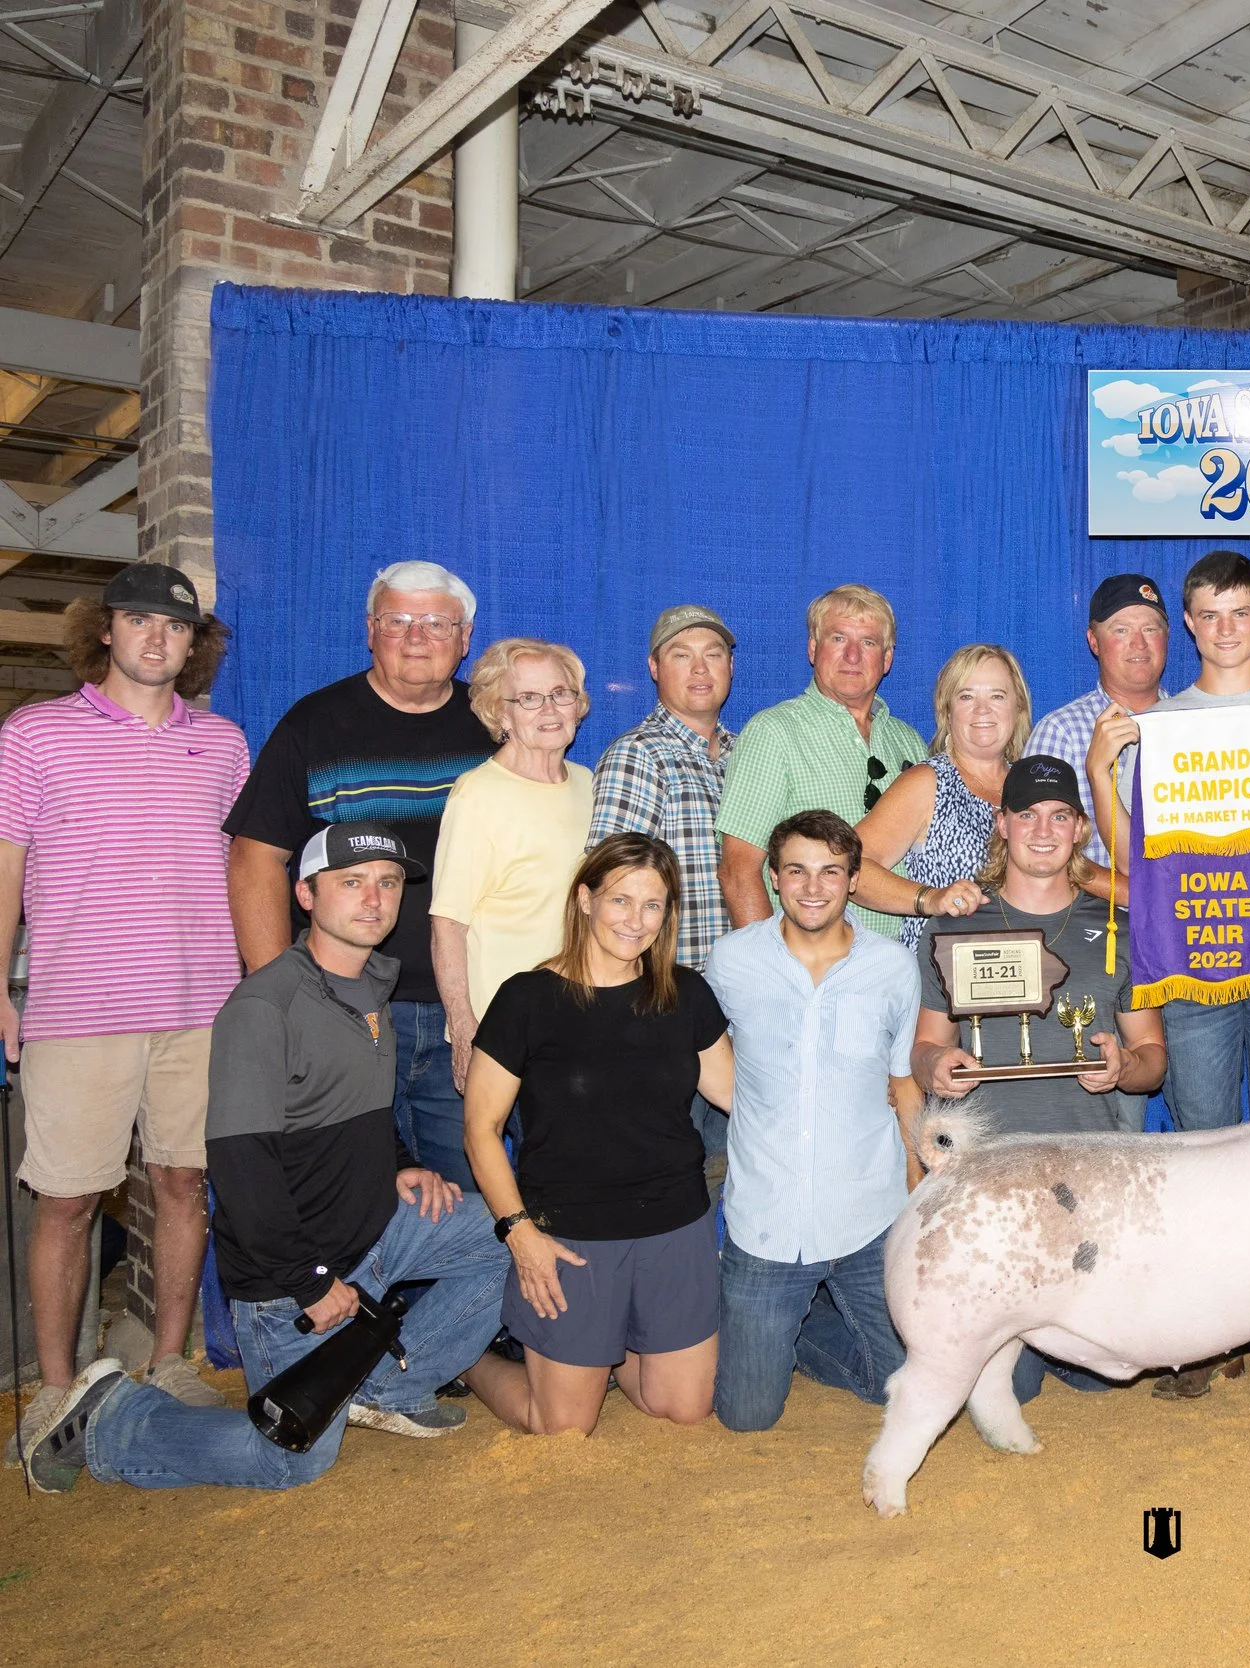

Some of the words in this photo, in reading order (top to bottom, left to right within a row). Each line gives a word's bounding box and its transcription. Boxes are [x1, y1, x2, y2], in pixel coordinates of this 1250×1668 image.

[1137, 391, 1229, 444] IOWA
[1157, 812, 1179, 824] 4-H
[1184, 809, 1237, 824] MARKET
[348, 835, 372, 847] TEAM
[1180, 871, 1249, 893] IOWA
[1186, 924, 1244, 945] FAIR
[1189, 951, 1243, 969] 2022
[979, 965, 1017, 979] 11-21
